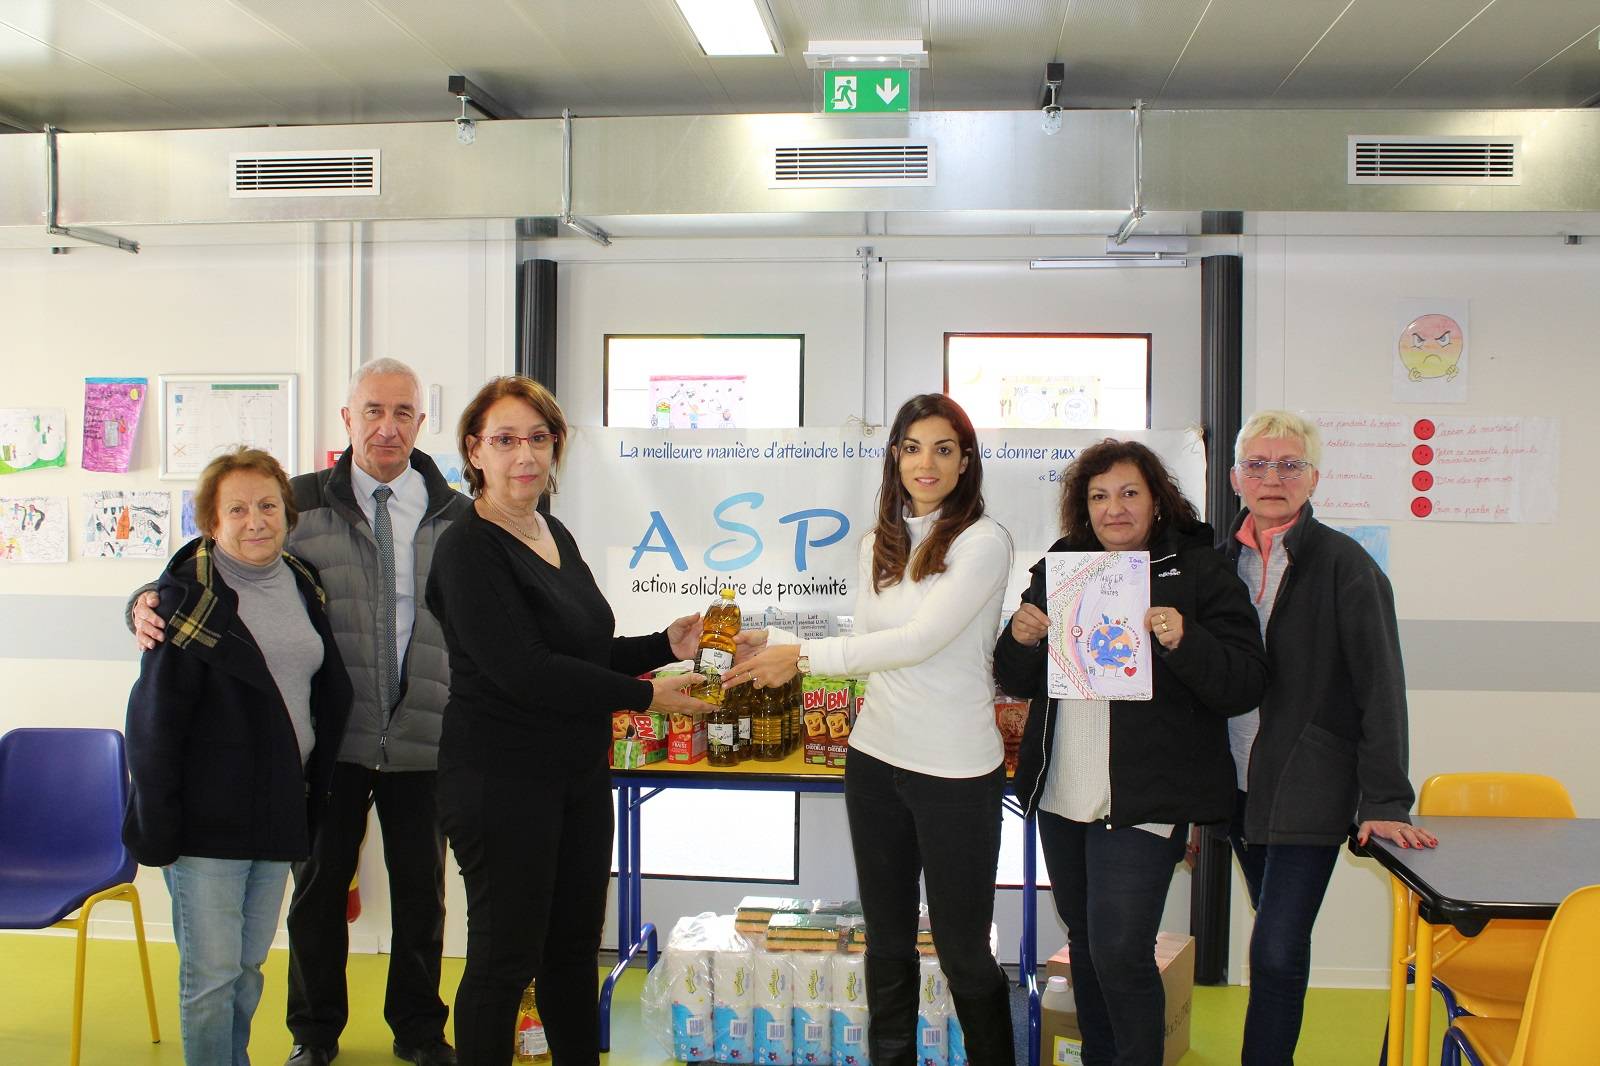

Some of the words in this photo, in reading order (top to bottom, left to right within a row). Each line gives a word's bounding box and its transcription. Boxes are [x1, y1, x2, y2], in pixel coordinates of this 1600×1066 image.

[619, 441, 639, 459] La
[643, 442, 703, 460] meilleure
[706, 442, 760, 460] manière
[764, 441, 839, 460] d'atteindre
[842, 441, 855, 459] le
[996, 442, 1049, 461] donner
[1051, 448, 1075, 461] aux
[632, 573, 676, 594] action
[681, 576, 746, 596] solidaire
[752, 576, 772, 596] de
[777, 576, 848, 602] proximité
[804, 688, 826, 710] BN
[827, 688, 849, 711] BN
[634, 715, 657, 740] BN
